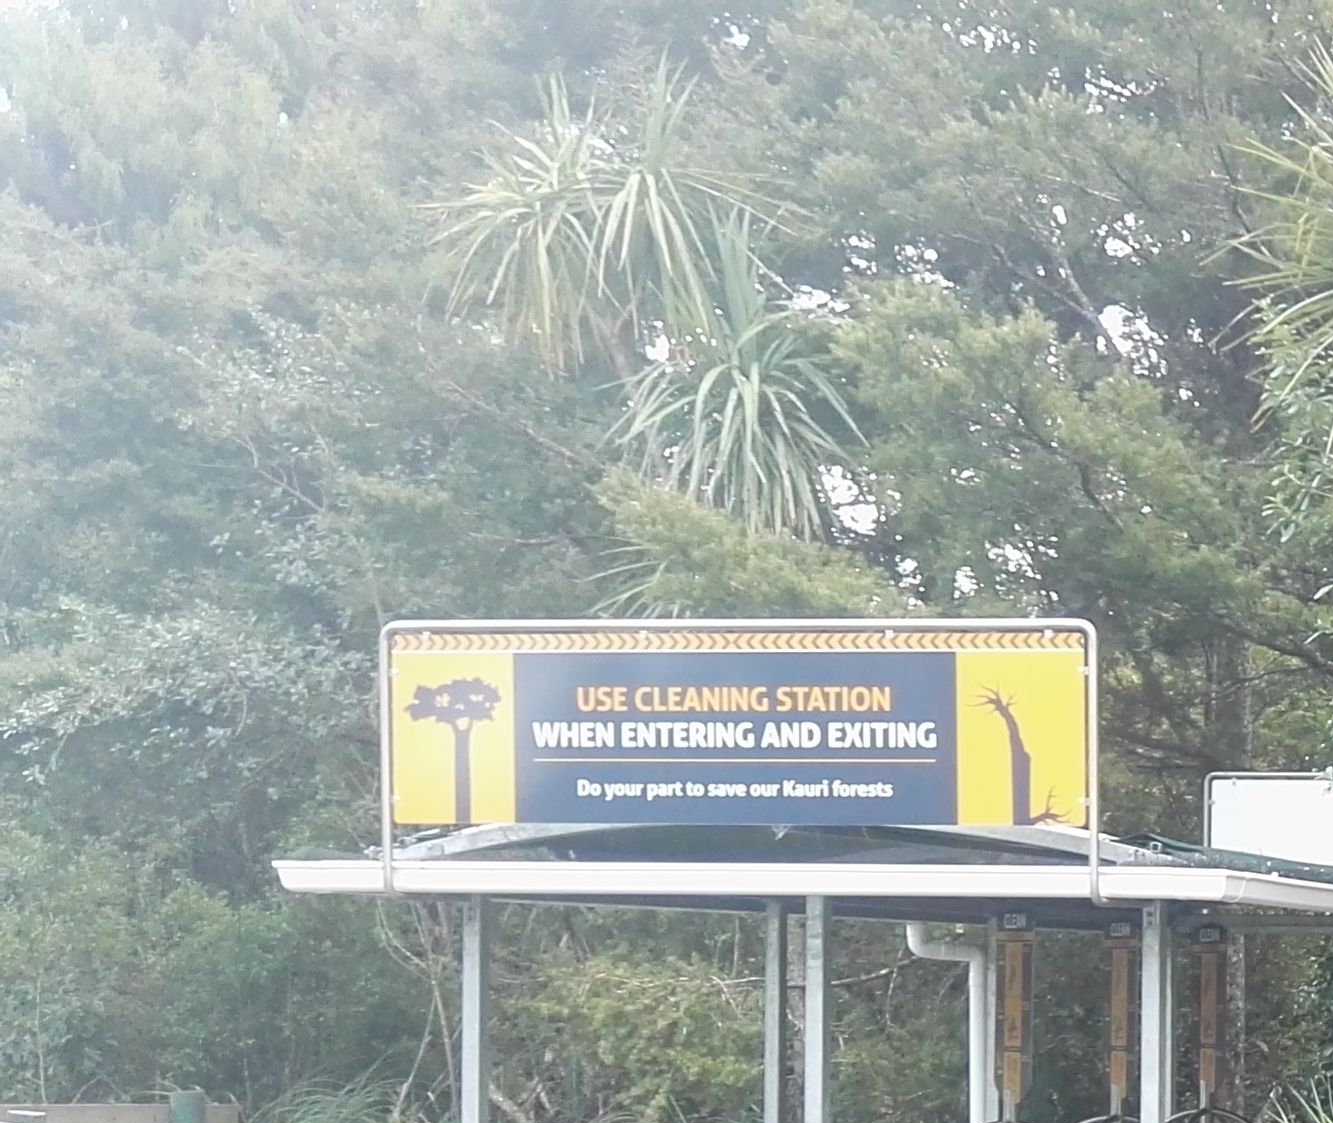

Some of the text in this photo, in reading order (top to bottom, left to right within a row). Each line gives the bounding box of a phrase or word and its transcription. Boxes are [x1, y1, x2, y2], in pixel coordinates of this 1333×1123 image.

[576, 686, 892, 712] USE CLEANING STATION
[532, 721, 938, 749] WHEN ENTERING AND EXITING
[576, 778, 894, 801] Do your part to save our Kauri forests
